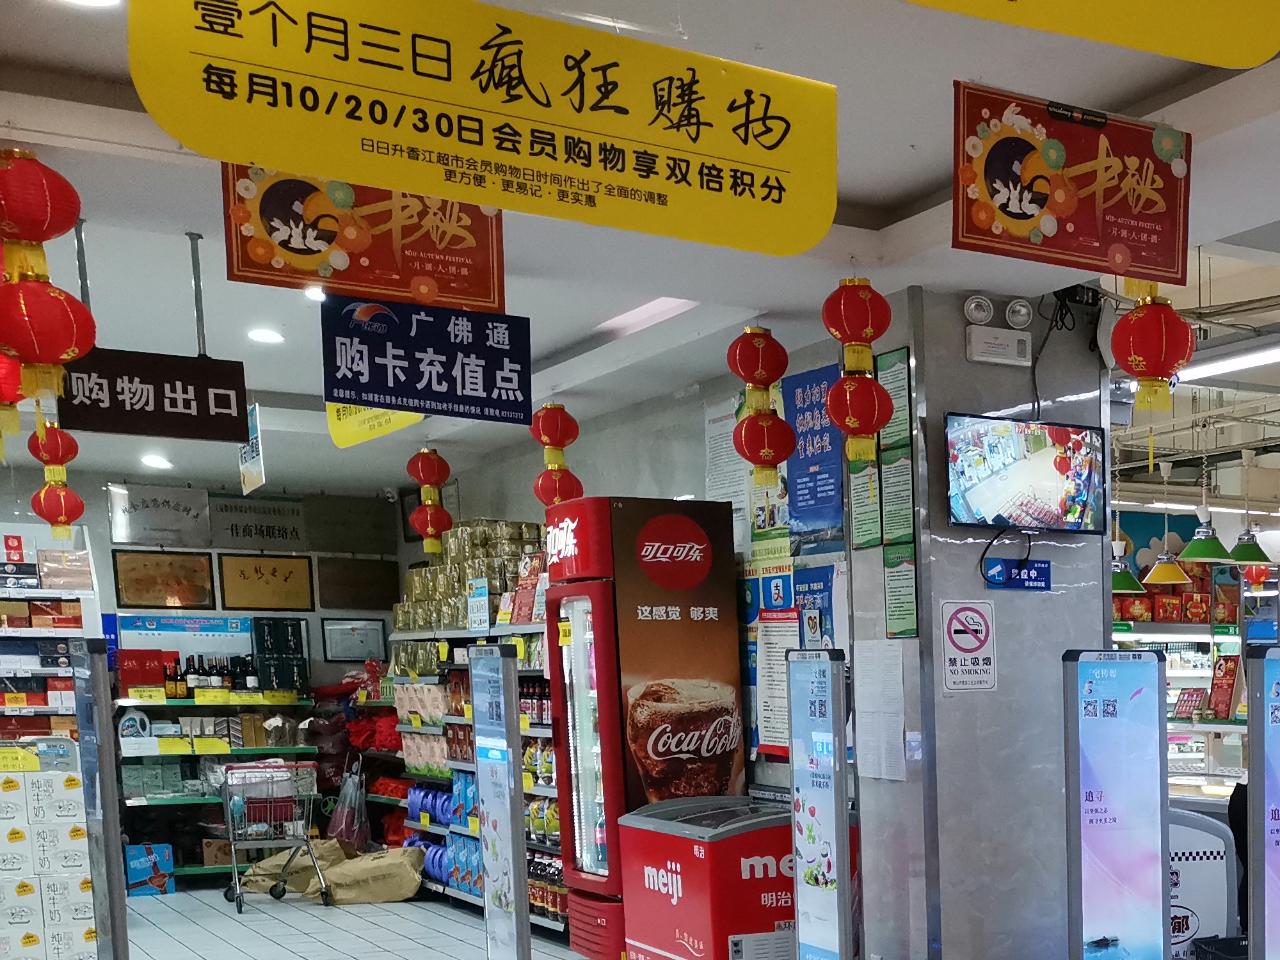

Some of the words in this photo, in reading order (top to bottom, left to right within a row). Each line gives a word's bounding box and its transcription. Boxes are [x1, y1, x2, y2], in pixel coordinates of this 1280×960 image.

[202, 64, 788, 205] 每月10/20/30日会员购物享双倍积分
[410, 312, 511, 349] 广佛通
[335, 336, 525, 402] 购卡充值点
[71, 371, 239, 418] 购物出口
[641, 542, 708, 562] 可口可乐
[637, 606, 681, 621] 这感觉
[689, 606, 719, 621] 够爽
[948, 656, 992, 667] 禁止吸烟
[960, 668, 991, 676] SMOKING
[647, 712, 743, 761] Coca-Cola
[643, 861, 683, 905] meiji
